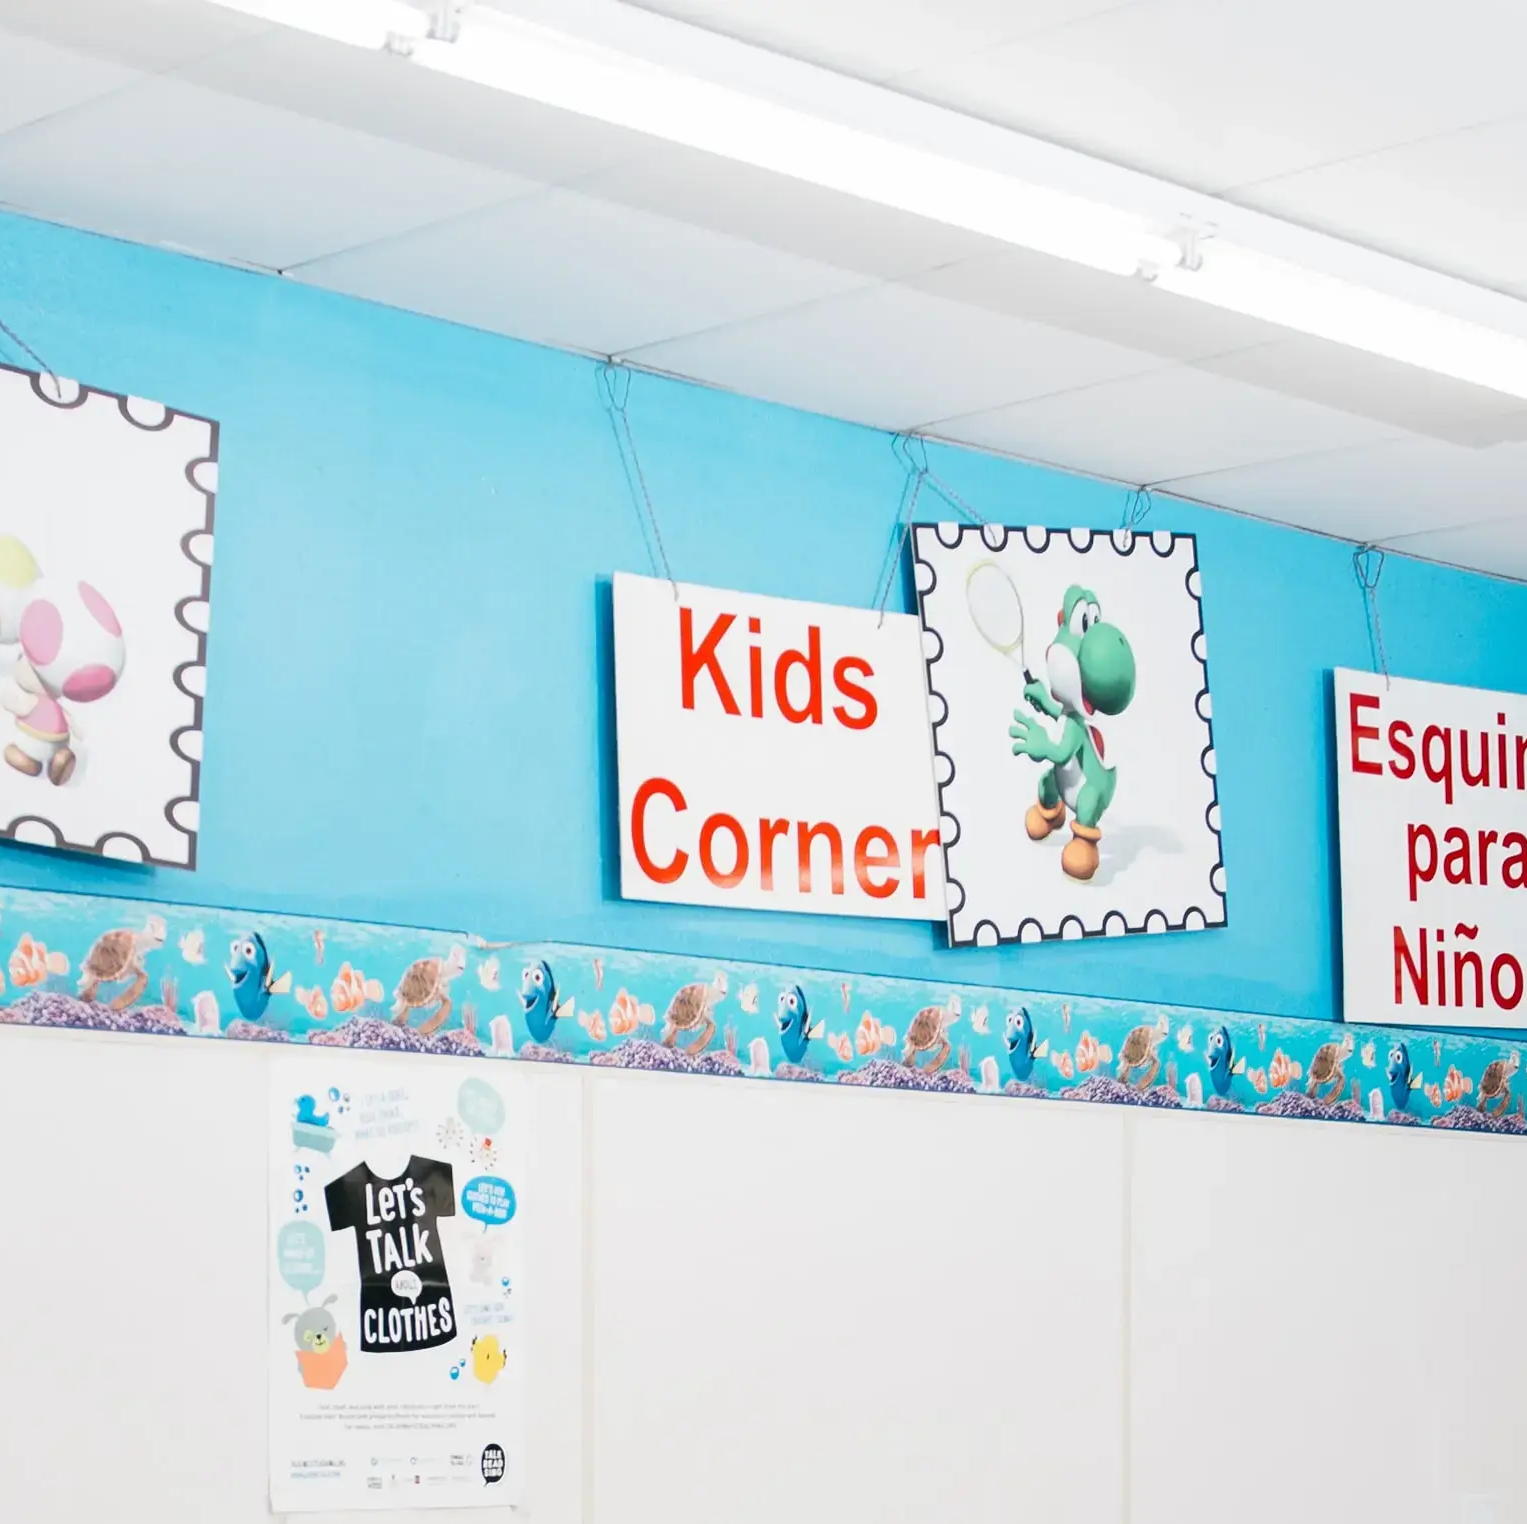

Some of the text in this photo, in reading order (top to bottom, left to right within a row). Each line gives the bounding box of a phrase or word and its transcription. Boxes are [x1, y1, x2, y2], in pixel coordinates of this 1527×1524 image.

[678, 606, 878, 729] Kids
[631, 777, 940, 898] Corner
[366, 1223, 433, 1274] TALK
[364, 1296, 452, 1344] CLOTHES
